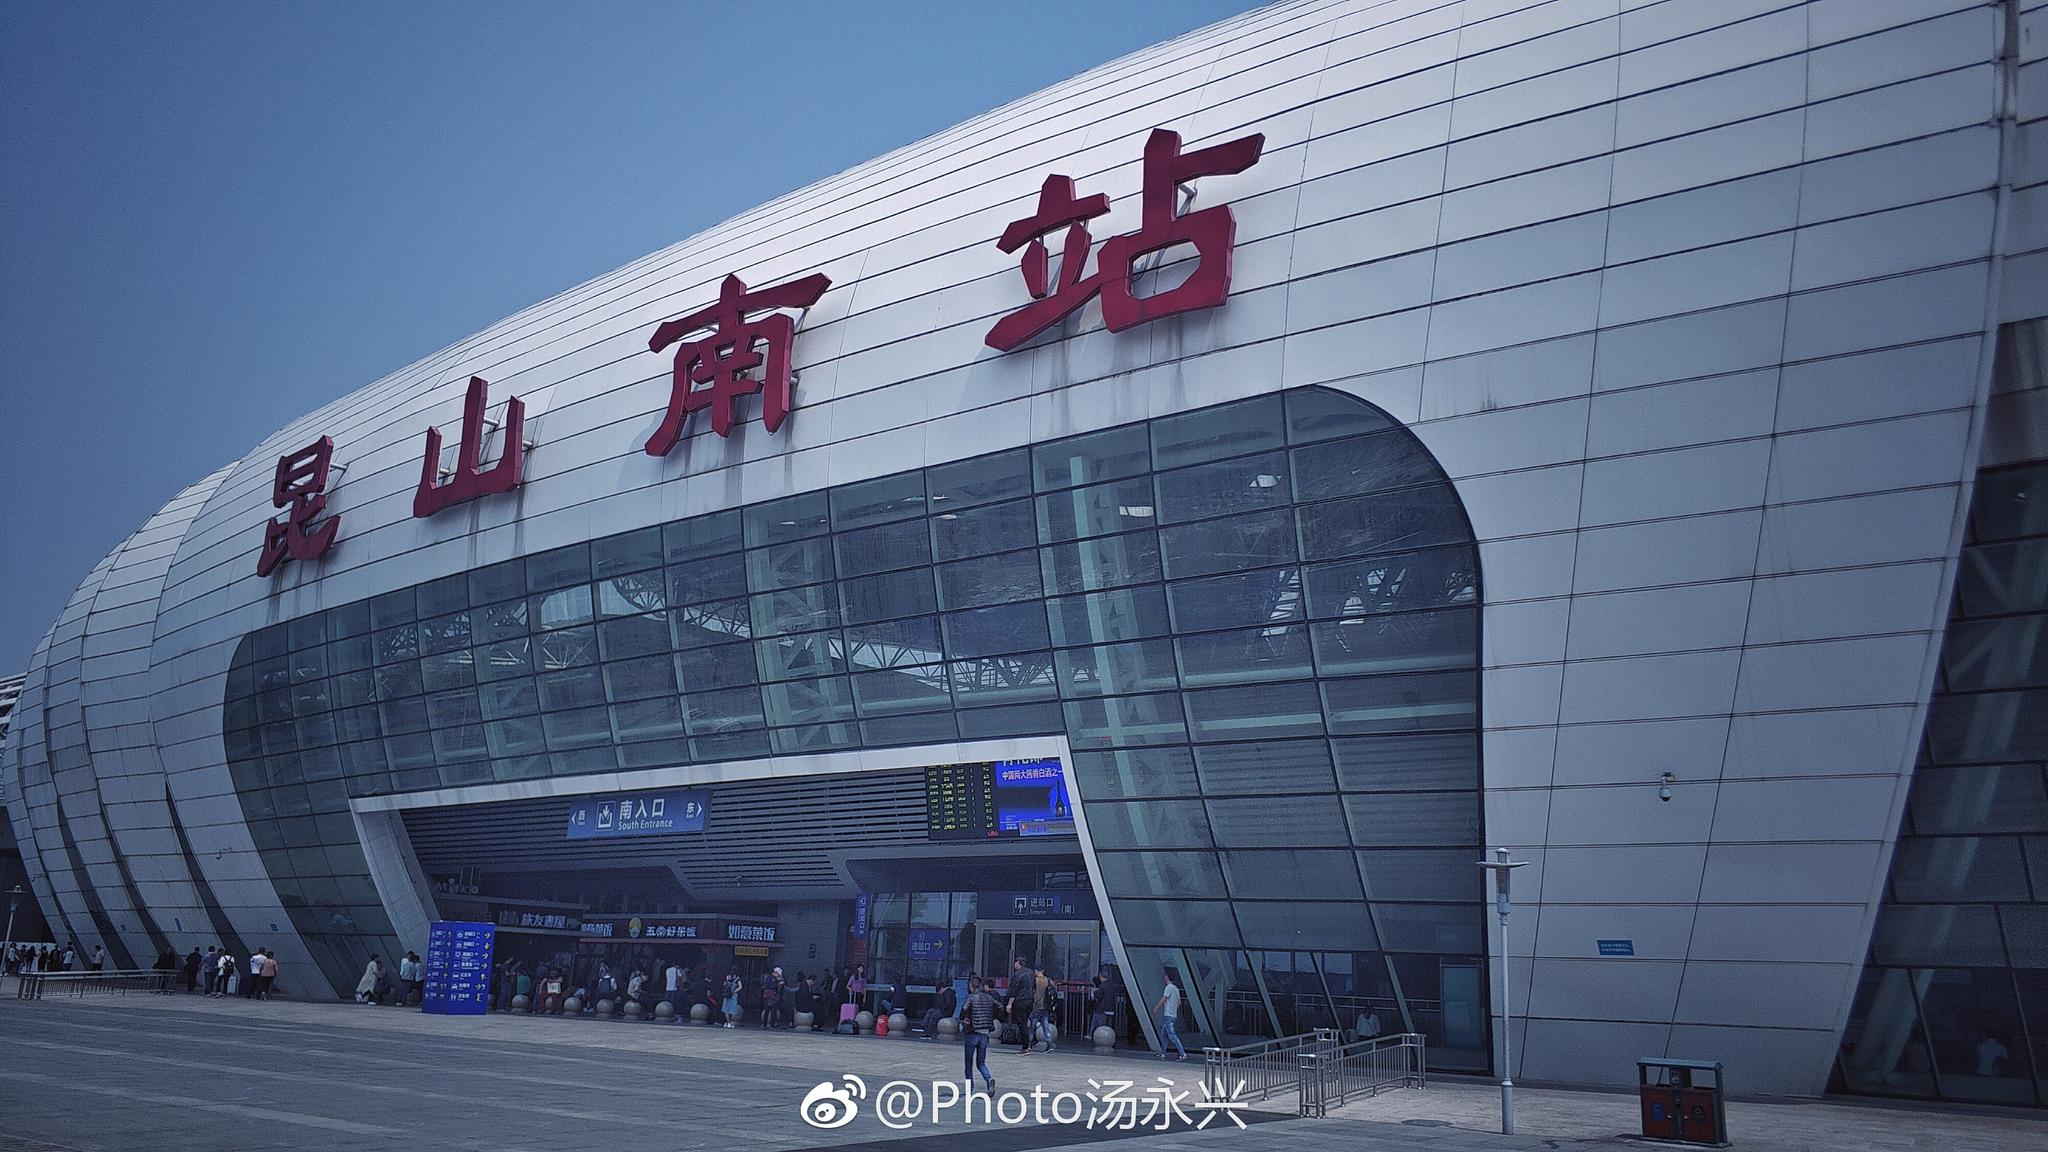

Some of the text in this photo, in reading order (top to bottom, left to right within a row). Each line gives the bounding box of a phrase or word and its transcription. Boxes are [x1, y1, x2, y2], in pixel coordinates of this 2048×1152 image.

[256, 128, 1265, 577] 昆山南站
[619, 798, 665, 820] 南入口
[618, 819, 674, 831] South Entrance
[1030, 896, 1054, 907] 进站口
[728, 924, 775, 941] 如意菜饭
